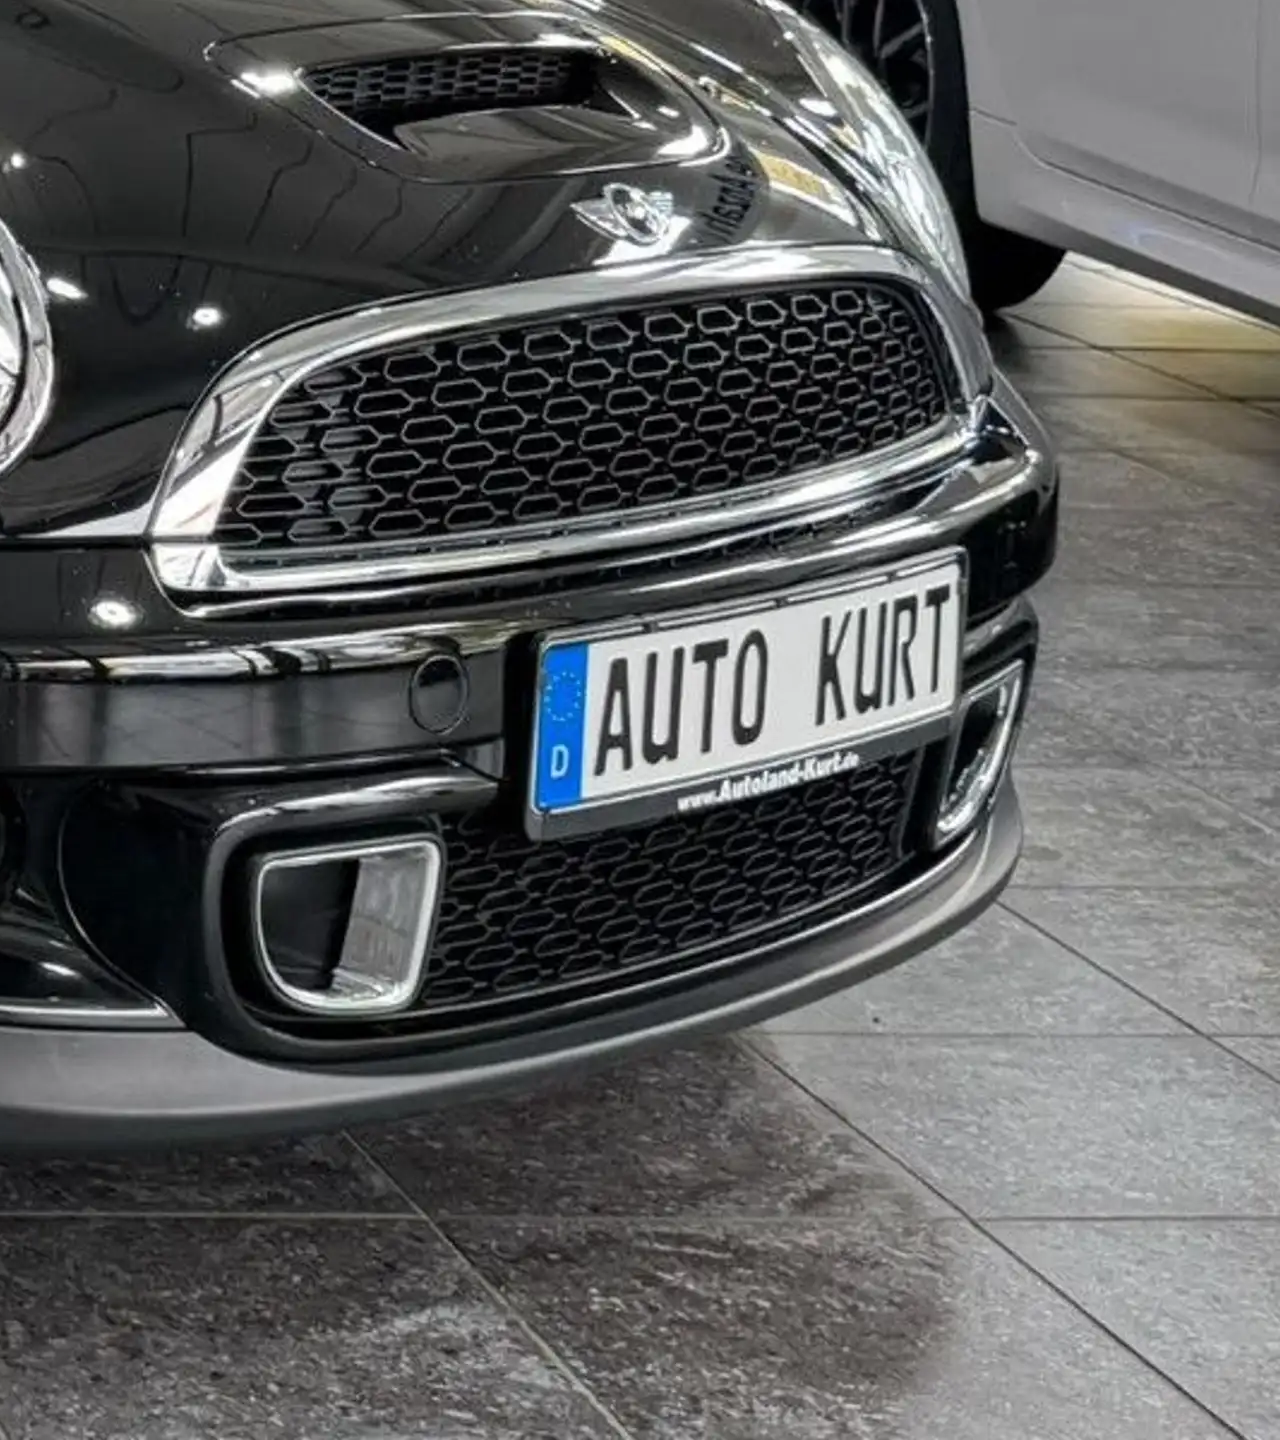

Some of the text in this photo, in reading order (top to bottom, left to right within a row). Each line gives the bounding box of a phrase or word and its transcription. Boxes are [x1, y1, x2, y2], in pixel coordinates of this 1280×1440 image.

[550, 584, 951, 780] D AUTO KURT
[677, 751, 860, 812] www.Autoland-Kurt.de
